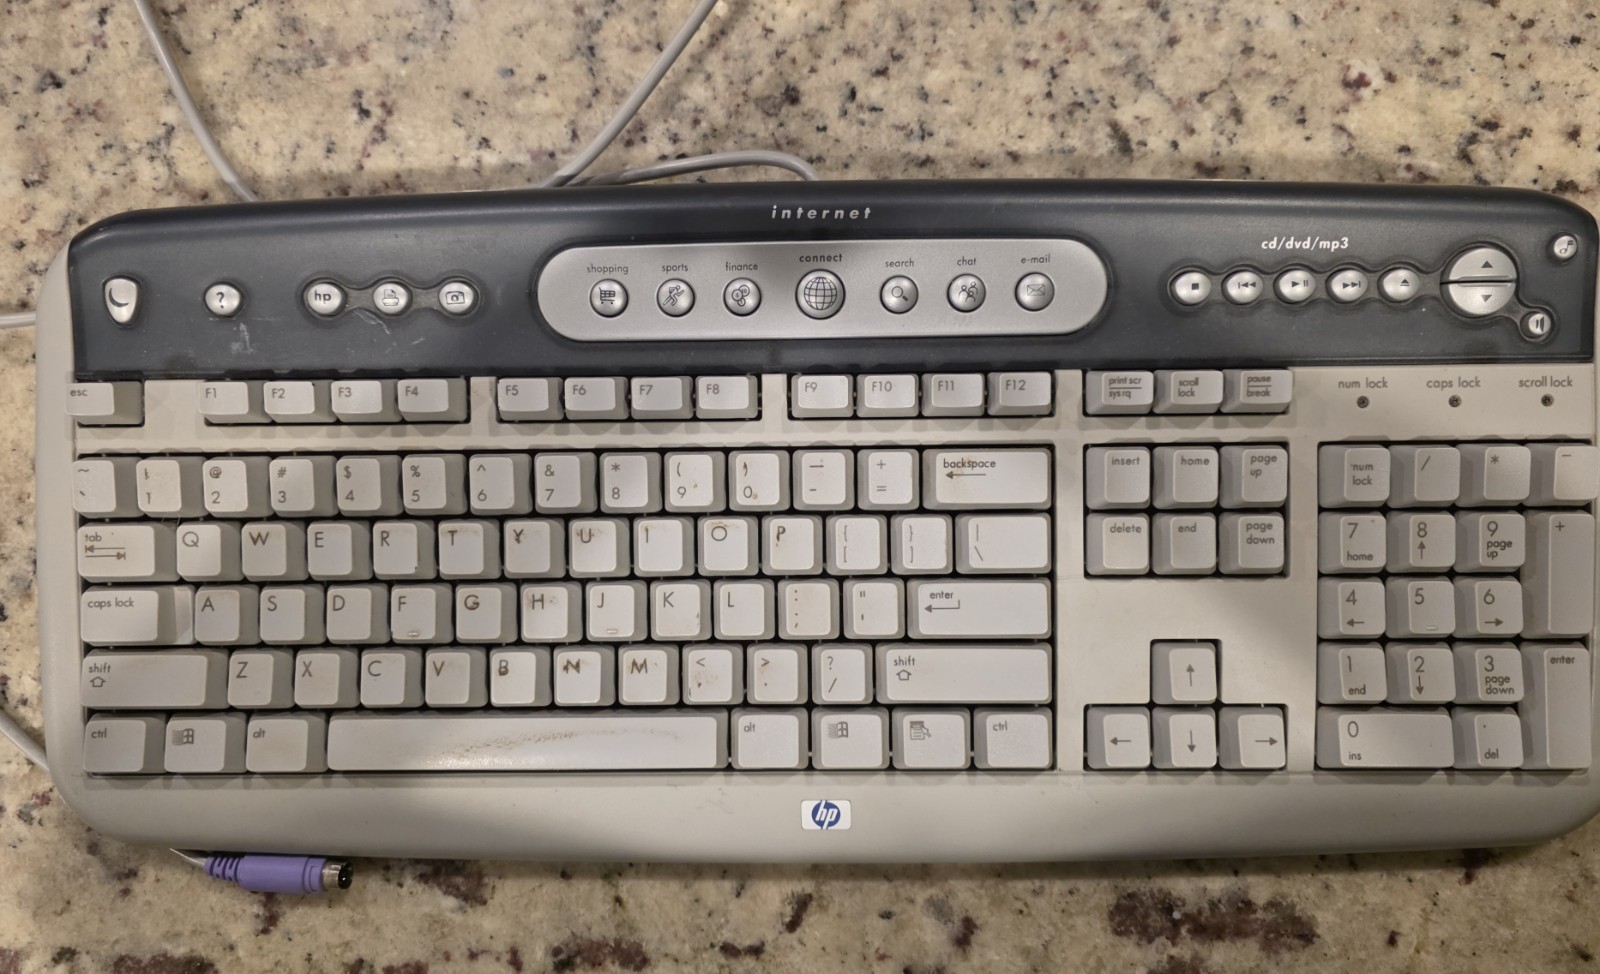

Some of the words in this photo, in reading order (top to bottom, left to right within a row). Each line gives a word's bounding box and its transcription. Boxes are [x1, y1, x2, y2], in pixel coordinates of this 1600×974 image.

[771, 205, 872, 219] internet
[1261, 236, 1349, 252] cd/dvd/mp3
[799, 253, 842, 263] connect
[885, 258, 914, 268] search
[957, 257, 976, 266] chat
[1021, 254, 1050, 264] e-mail
[587, 264, 628, 274] shopping
[661, 263, 689, 272] sports
[725, 262, 758, 271] finance
[314, 290, 331, 304] hp
[1006, 380, 1026, 390] F12
[1109, 377, 1127, 386] print
[1129, 377, 1141, 385] scr
[1179, 377, 1199, 387] scroll
[1247, 376, 1271, 384] pause
[1338, 380, 1361, 389] num
[1366, 377, 1388, 388] lock
[1426, 379, 1454, 390] caps
[1458, 377, 1480, 388] lock
[1519, 376, 1547, 387] scroll
[1550, 376, 1573, 387] lock
[405, 386, 419, 397] F4
[505, 385, 519, 395] F5
[572, 385, 586, 395] F6
[640, 384, 653, 395] F7
[706, 384, 720, 394] F8
[804, 382, 818, 392] F9
[872, 381, 892, 392] F10
[938, 381, 954, 391] F11
[70, 389, 88, 397] esc
[206, 388, 217, 398] F1
[272, 388, 285, 398] F2
[339, 387, 352, 398] F3
[1123, 391, 1131, 399] rq
[1178, 388, 1195, 397] lock
[1247, 388, 1271, 397] break
[943, 458, 996, 470] backspace
[1112, 456, 1140, 465] insert
[1181, 455, 1209, 465] home
[1250, 455, 1277, 464] page
[1353, 463, 1373, 471] num
[1250, 469, 1261, 478] up
[1353, 476, 1372, 485] lock
[278, 491, 287, 503] 3
[346, 489, 354, 502] 4
[412, 490, 420, 502] 5
[478, 489, 487, 502] 6
[545, 489, 554, 501] 7
[612, 487, 620, 500] 8
[677, 486, 687, 498] 9
[743, 486, 752, 498] 0
[211, 492, 220, 504] 2
[1110, 523, 1141, 533] delete
[1178, 523, 1197, 533] end
[1246, 523, 1273, 532] page
[1348, 523, 1358, 539] 7
[1417, 522, 1427, 538] 8
[1487, 521, 1498, 536] 9
[85, 532, 102, 542] tab
[250, 532, 269, 546] W
[381, 531, 390, 547] R
[448, 530, 458, 546] T
[513, 529, 524, 544] Y
[580, 528, 592, 544] U
[711, 526, 727, 541] O
[776, 526, 786, 542] P
[182, 531, 199, 548] Q
[314, 532, 324, 547] E
[1246, 535, 1275, 544] down
[1487, 540, 1512, 550] page
[1347, 551, 1373, 561] home
[1487, 550, 1498, 560] up
[597, 593, 605, 608] J
[663, 592, 674, 607] K
[727, 592, 734, 607] L
[929, 591, 954, 599] enter
[1346, 589, 1357, 605] 4
[1415, 588, 1424, 605] 5
[1484, 589, 1495, 604] 6
[87, 599, 112, 609] caps
[115, 598, 134, 607] lock
[202, 597, 215, 611] A
[268, 596, 277, 611] S
[333, 596, 345, 611] D
[399, 596, 406, 610] F
[464, 595, 479, 610] G
[531, 594, 544, 609] H
[893, 656, 915, 667] shift
[1414, 656, 1425, 672] 2
[1484, 655, 1494, 671] 3
[1550, 656, 1575, 664] enter
[89, 663, 111, 673] shift
[236, 662, 248, 678] Z
[302, 662, 312, 677] X
[368, 661, 382, 677] C
[433, 661, 444, 676] V
[498, 660, 508, 675] B
[563, 659, 580, 673] N
[631, 659, 648, 673] M
[1485, 675, 1510, 685] page
[1349, 685, 1366, 695] end
[1486, 685, 1514, 695] down
[744, 722, 755, 732] alt
[993, 721, 1008, 731] ctrl
[1348, 721, 1359, 738] 0
[91, 728, 107, 738] ctrl
[253, 728, 265, 738] alt
[1349, 752, 1361, 761] ins
[1484, 749, 1499, 759] del
[815, 800, 838, 829] hp
